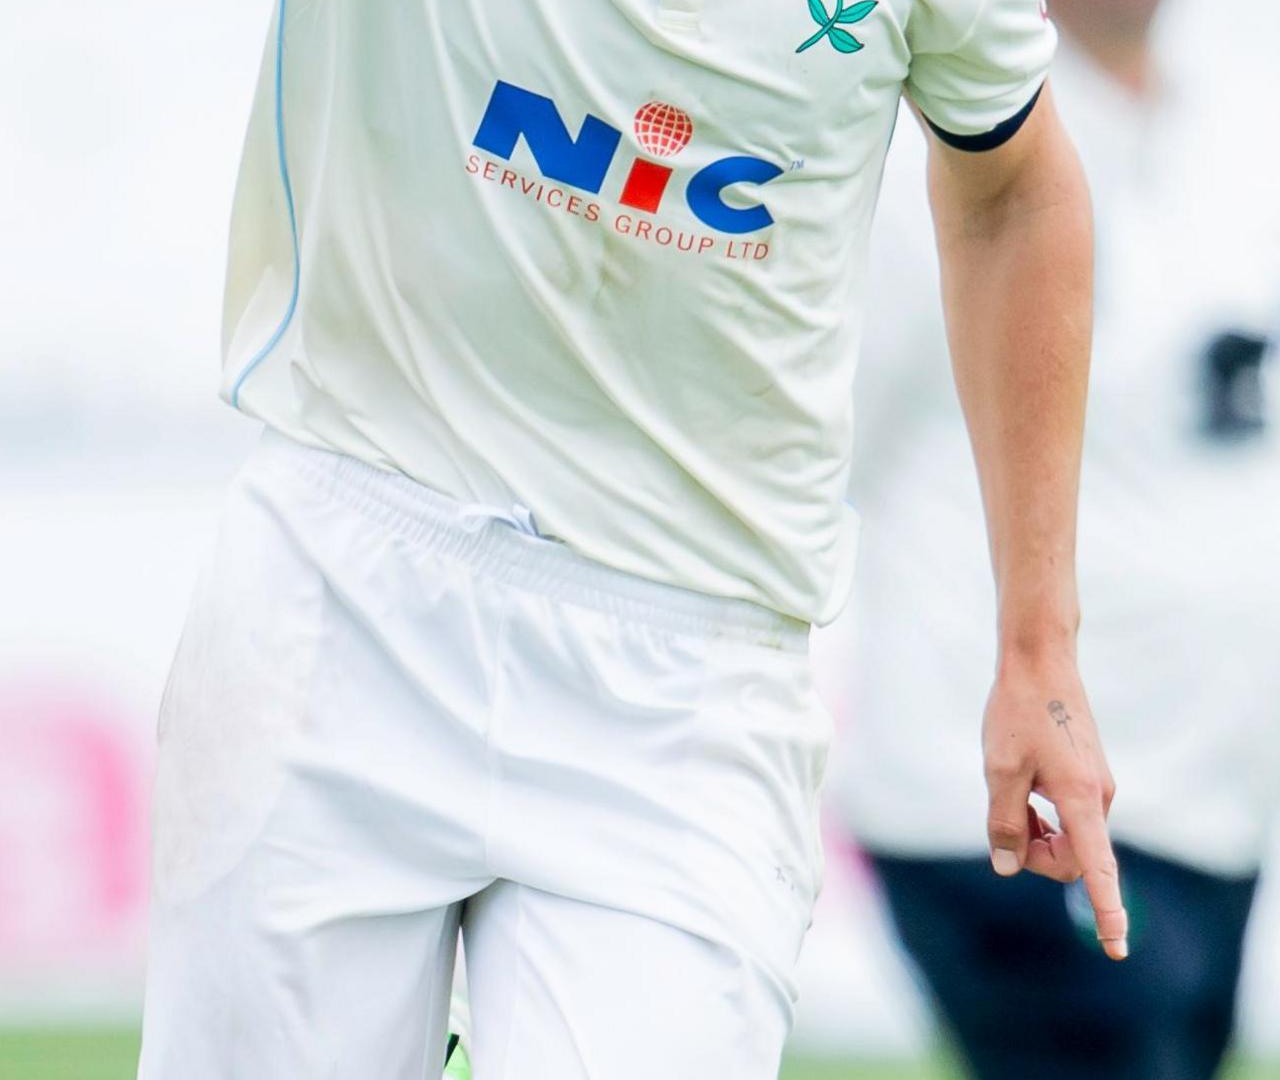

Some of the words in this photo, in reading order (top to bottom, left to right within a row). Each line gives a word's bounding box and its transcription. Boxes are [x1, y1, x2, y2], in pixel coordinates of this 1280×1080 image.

[465, 154, 601, 222] SERVICES
[615, 214, 714, 255] GROUP
[726, 240, 770, 261] LTD
